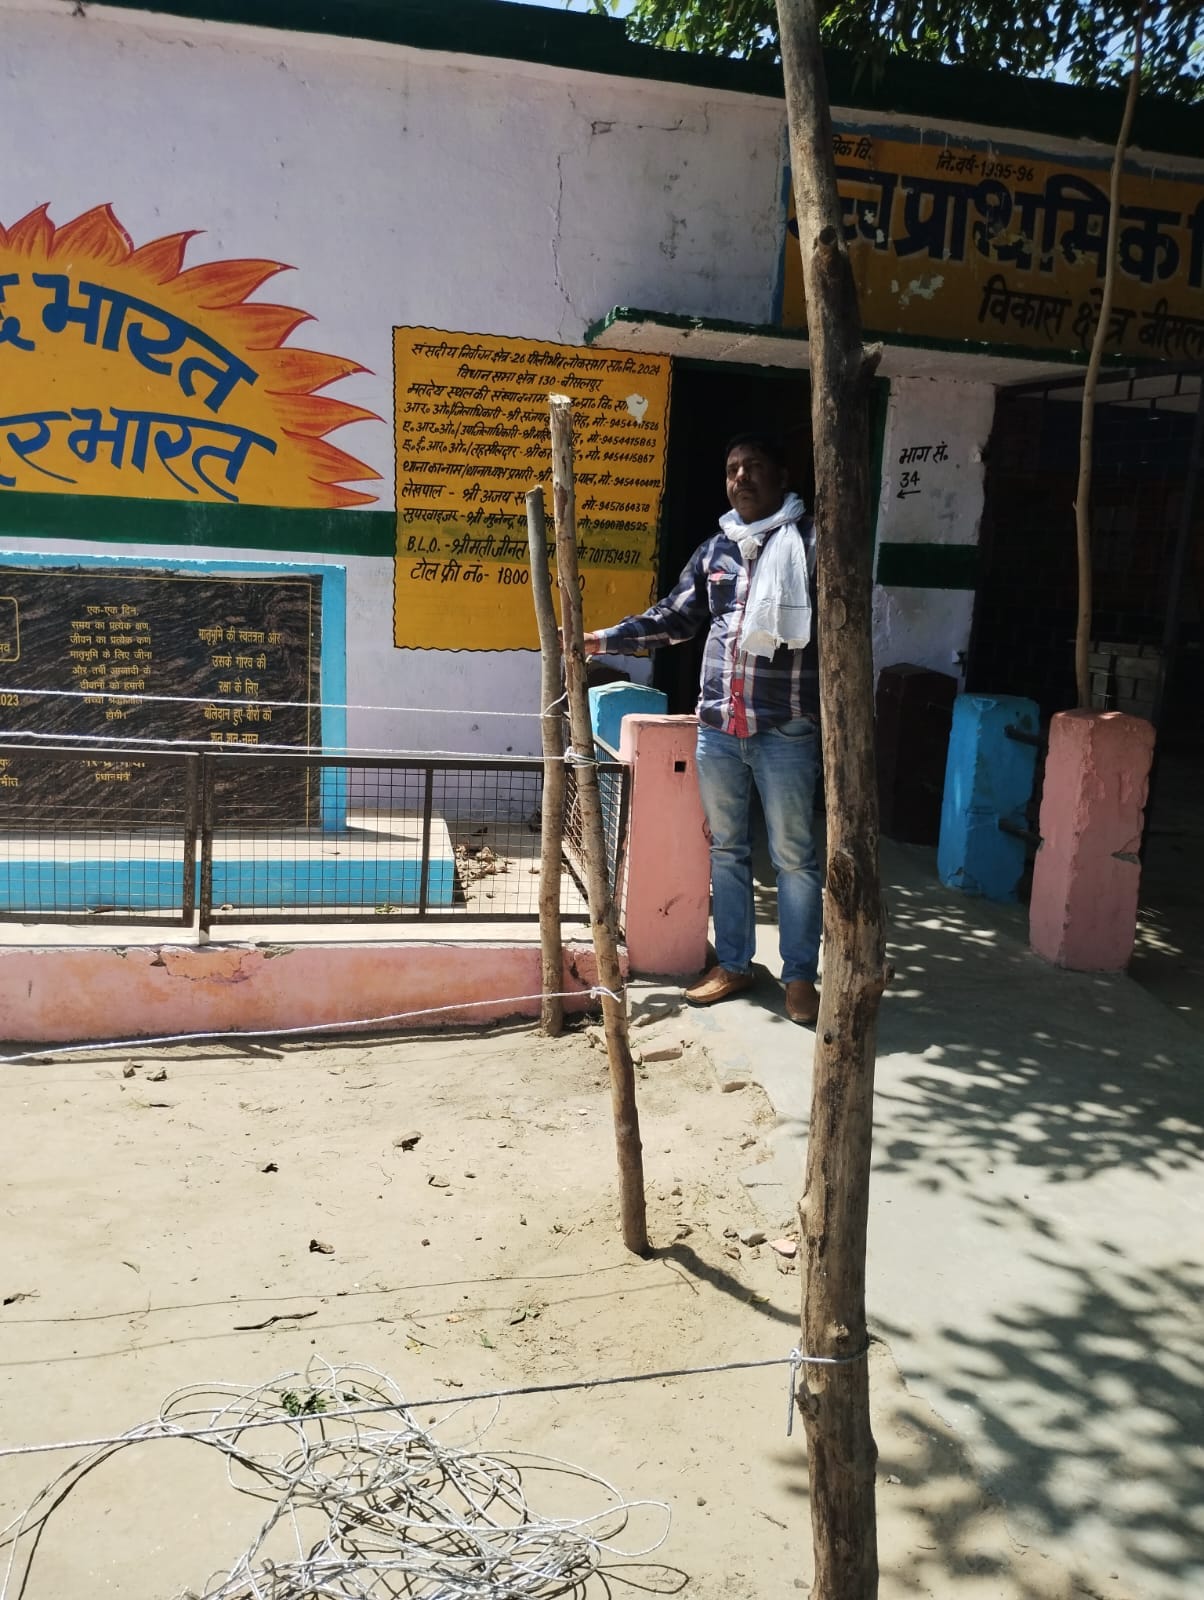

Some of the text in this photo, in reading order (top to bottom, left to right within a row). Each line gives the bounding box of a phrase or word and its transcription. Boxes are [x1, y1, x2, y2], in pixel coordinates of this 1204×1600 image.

[977, 273, 1072, 341] विकास
[1138, 298, 1204, 354] बीसल
[32, 272, 260, 414] भारत
[456, 363, 494, 382] विधान
[491, 371, 517, 384] सभा
[515, 370, 538, 386] क्षेत्र
[67, 406, 278, 504] भारत
[899, 446, 933, 464] भाग
[899, 470, 921, 488] 34
[401, 478, 448, 499] लेखपाल
[462, 482, 482, 503] श्री
[480, 489, 515, 504] अजय
[407, 535, 441, 555] B.L.O.
[410, 557, 441, 581] टोल
[439, 559, 463, 583] फ्री
[211, 651, 233, 669] उसके
[256, 652, 268, 671] की
[245, 678, 259, 697] लिए
[0, 693, 20, 707] 023
